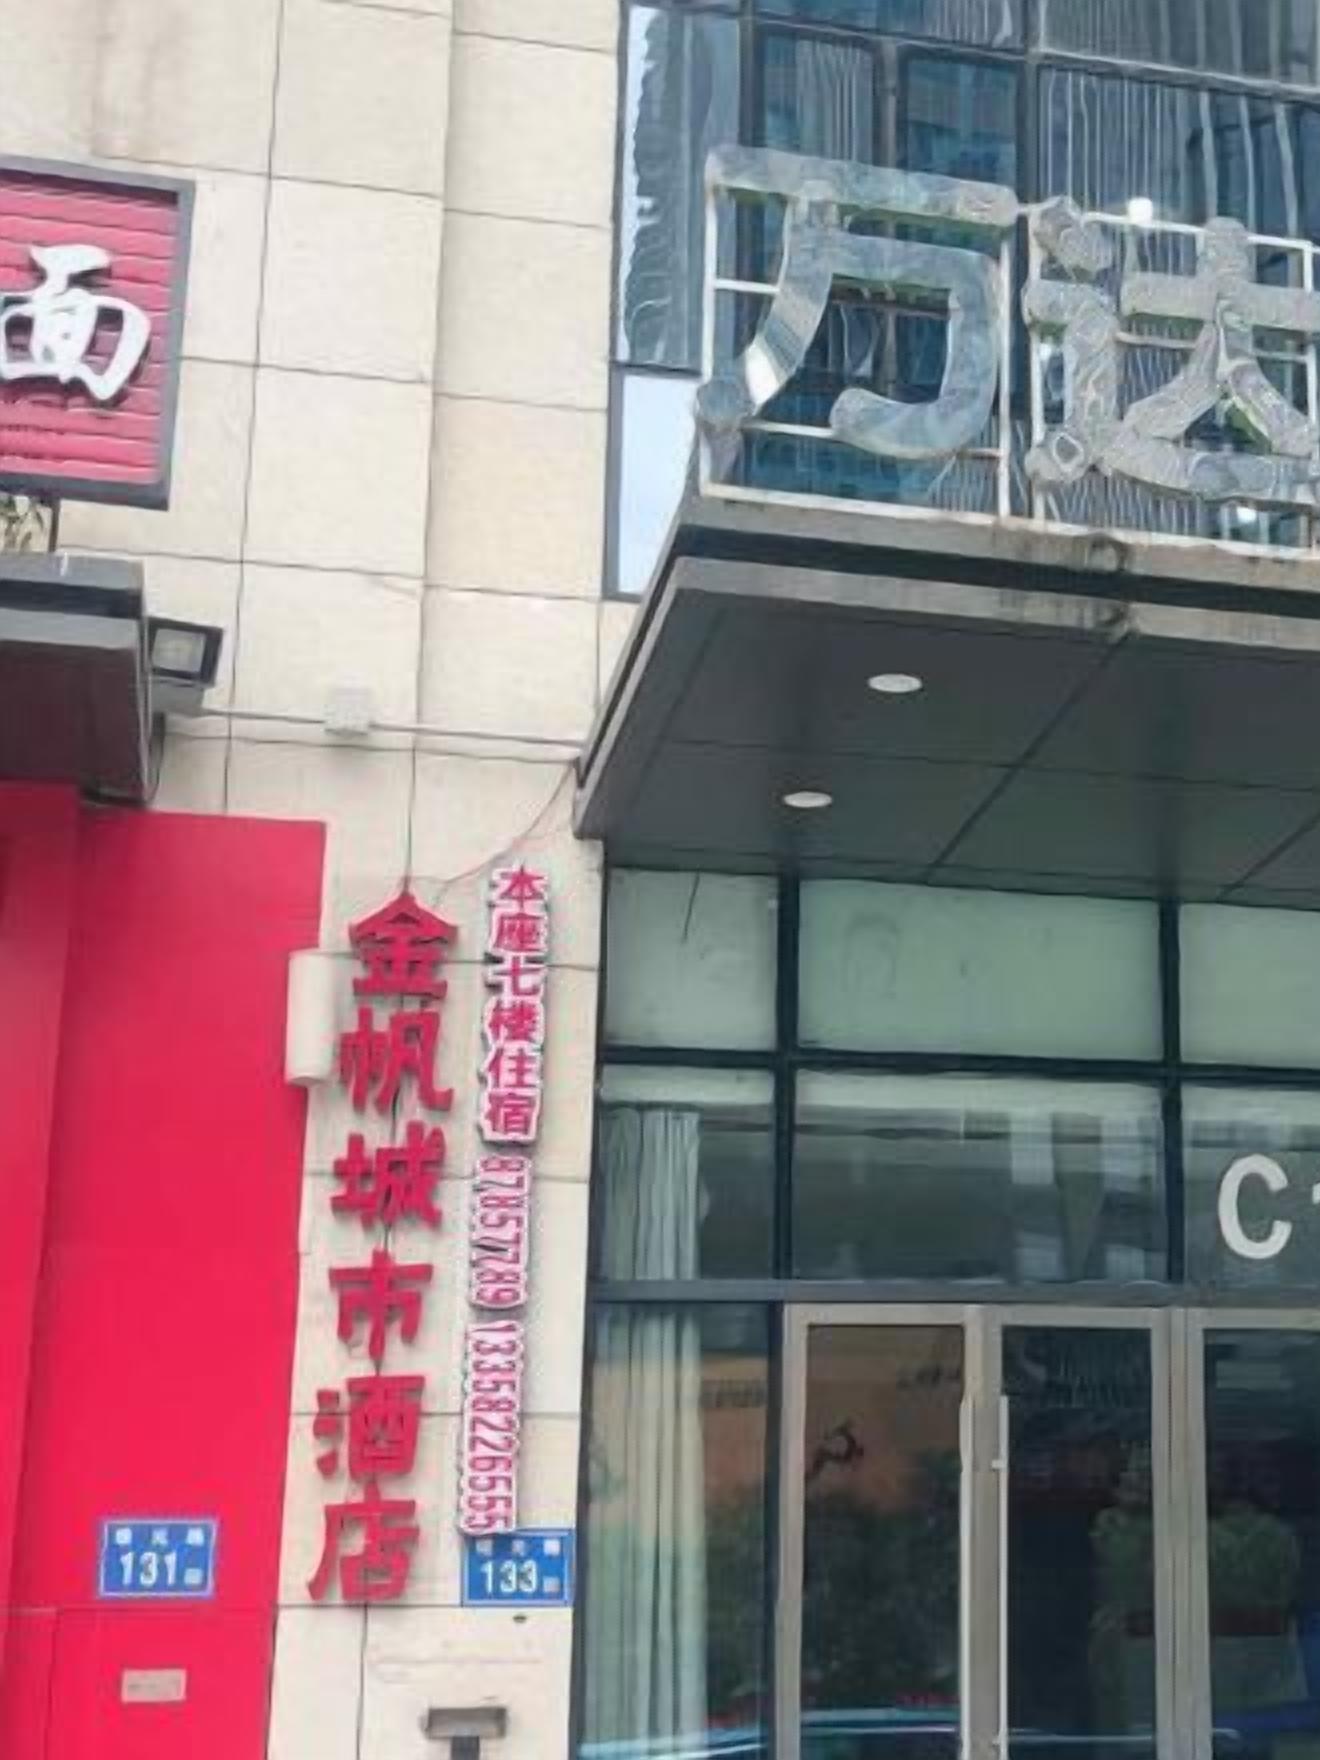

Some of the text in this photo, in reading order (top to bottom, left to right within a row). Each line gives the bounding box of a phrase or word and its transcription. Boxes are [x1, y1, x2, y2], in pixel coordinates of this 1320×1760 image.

[484, 863, 547, 1139] 本座七楼住宿
[308, 890, 458, 1602] 金帆城市酒店
[120, 1551, 203, 1586] 131
[481, 1559, 561, 1593] 133
